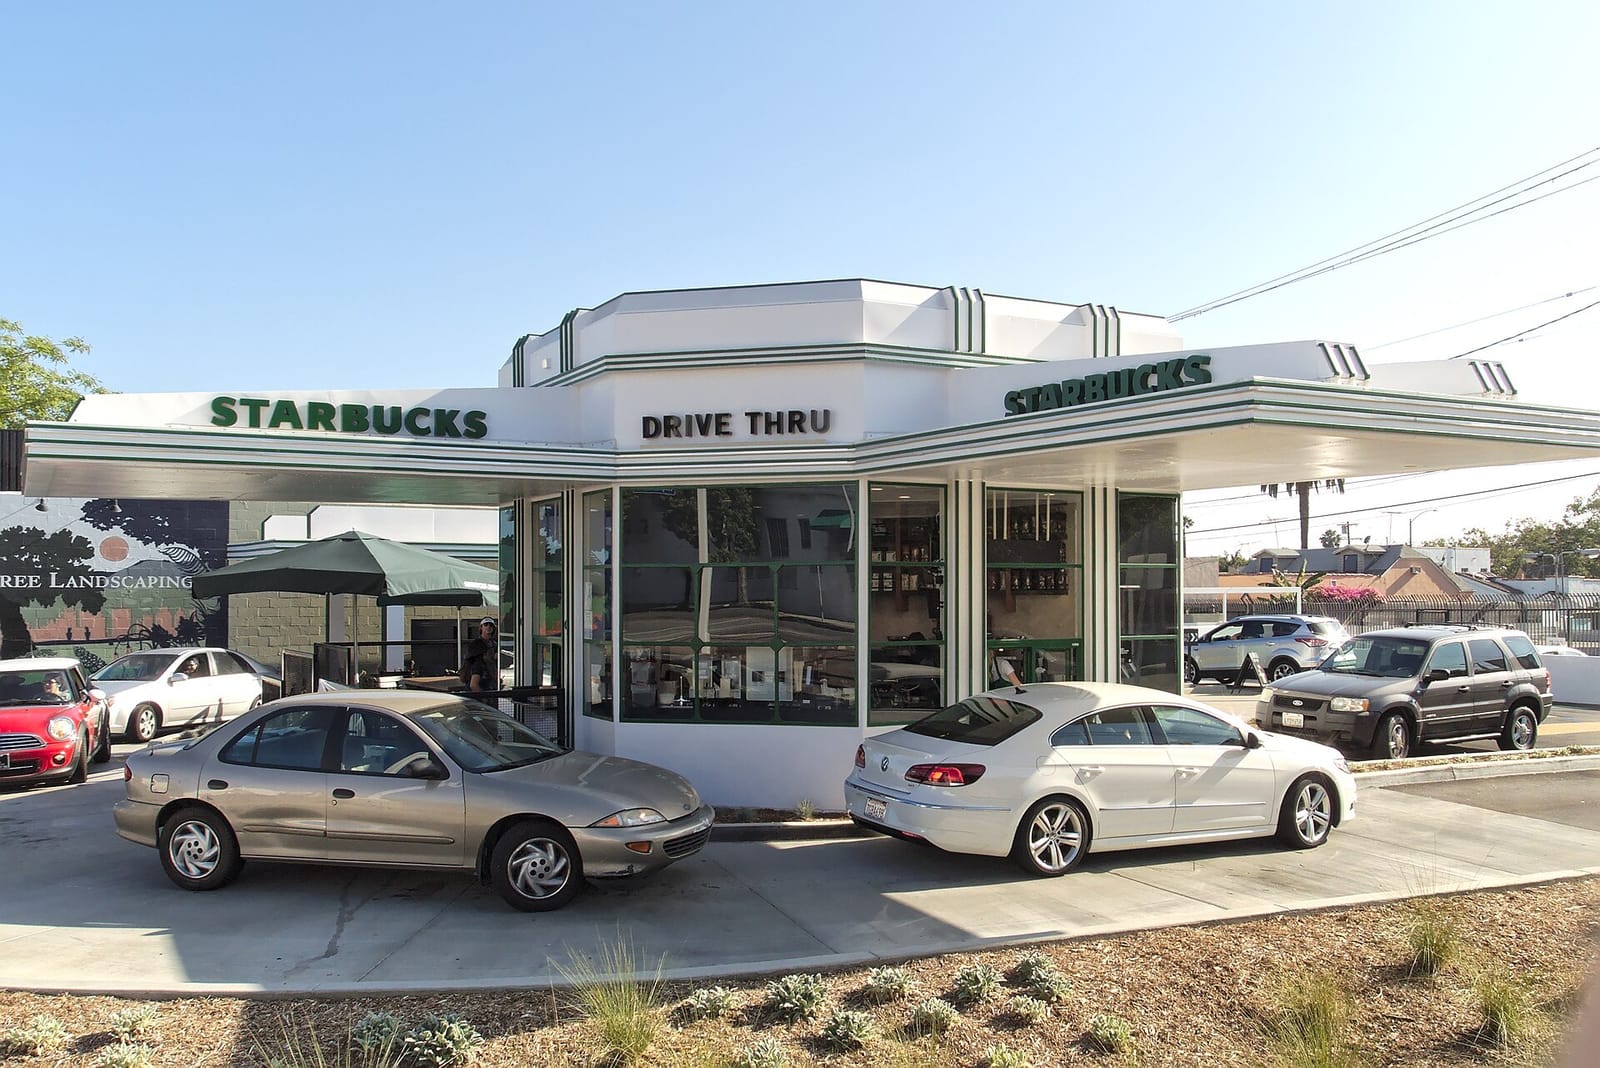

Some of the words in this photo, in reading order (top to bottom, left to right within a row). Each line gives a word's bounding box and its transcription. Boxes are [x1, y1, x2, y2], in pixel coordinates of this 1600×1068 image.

[1004, 355, 1212, 417] STARBUCKS
[210, 396, 487, 439] STARBUCKS
[642, 413, 733, 438] DRIVE
[745, 409, 831, 435] THRU
